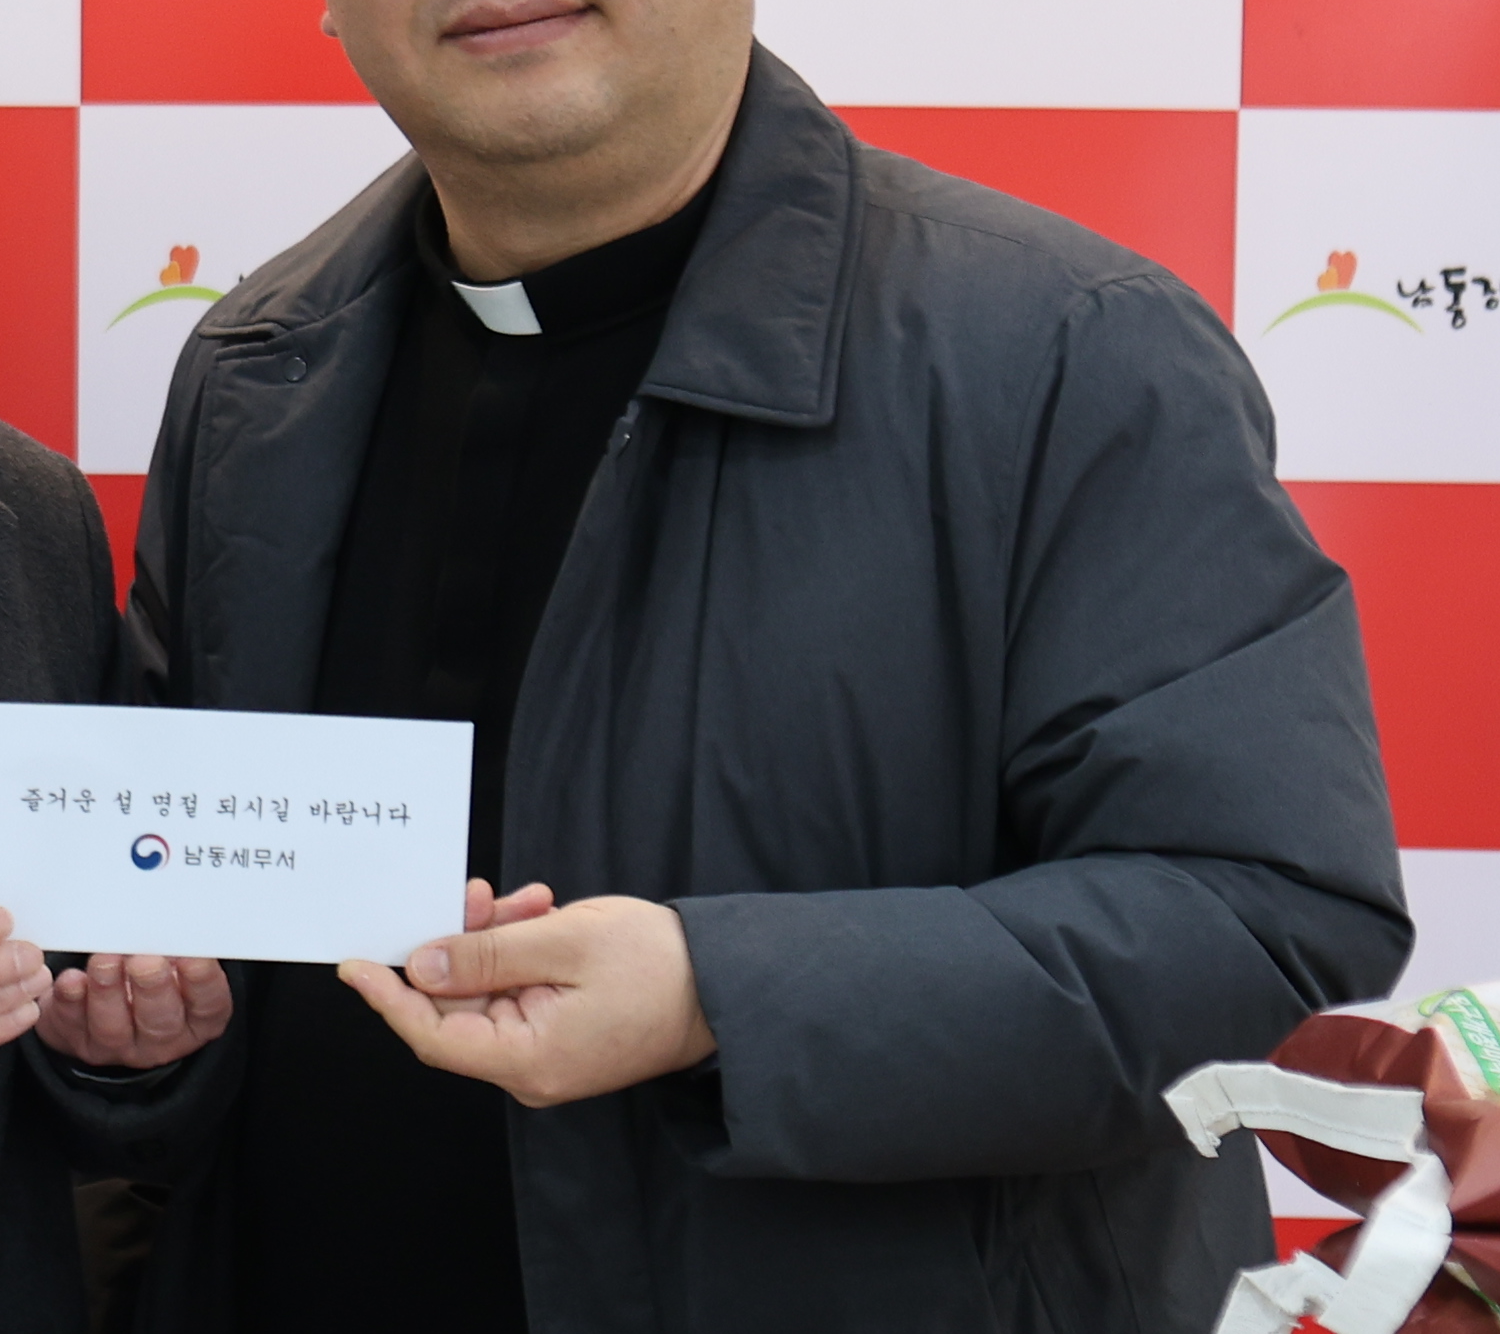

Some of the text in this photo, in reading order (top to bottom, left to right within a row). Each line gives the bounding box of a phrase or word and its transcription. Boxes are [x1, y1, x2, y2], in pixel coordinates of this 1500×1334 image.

[20, 787, 412, 827] 즐거운 설 명절 되시길 바랍니다
[184, 845, 297, 871] 남동세무서
